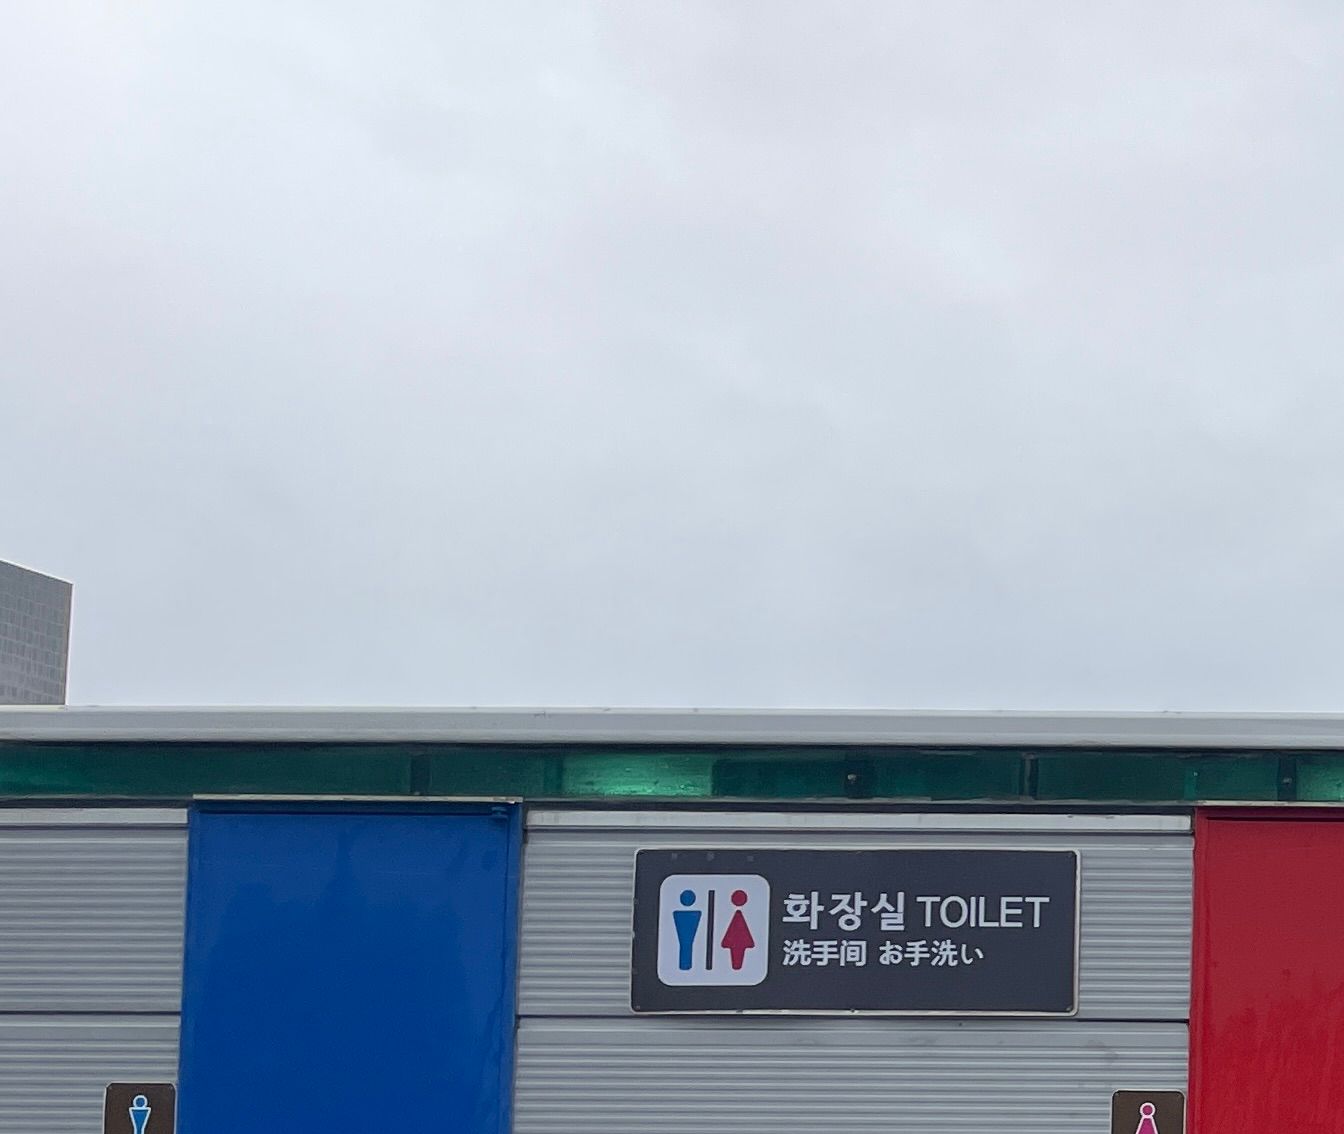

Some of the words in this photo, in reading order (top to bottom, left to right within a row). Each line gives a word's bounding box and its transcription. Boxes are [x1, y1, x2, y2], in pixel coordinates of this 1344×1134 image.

[781, 891, 906, 931] 화장실
[916, 895, 1050, 929] TOILET
[782, 940, 867, 967] 洗手间
[879, 940, 984, 967] お手洗い
